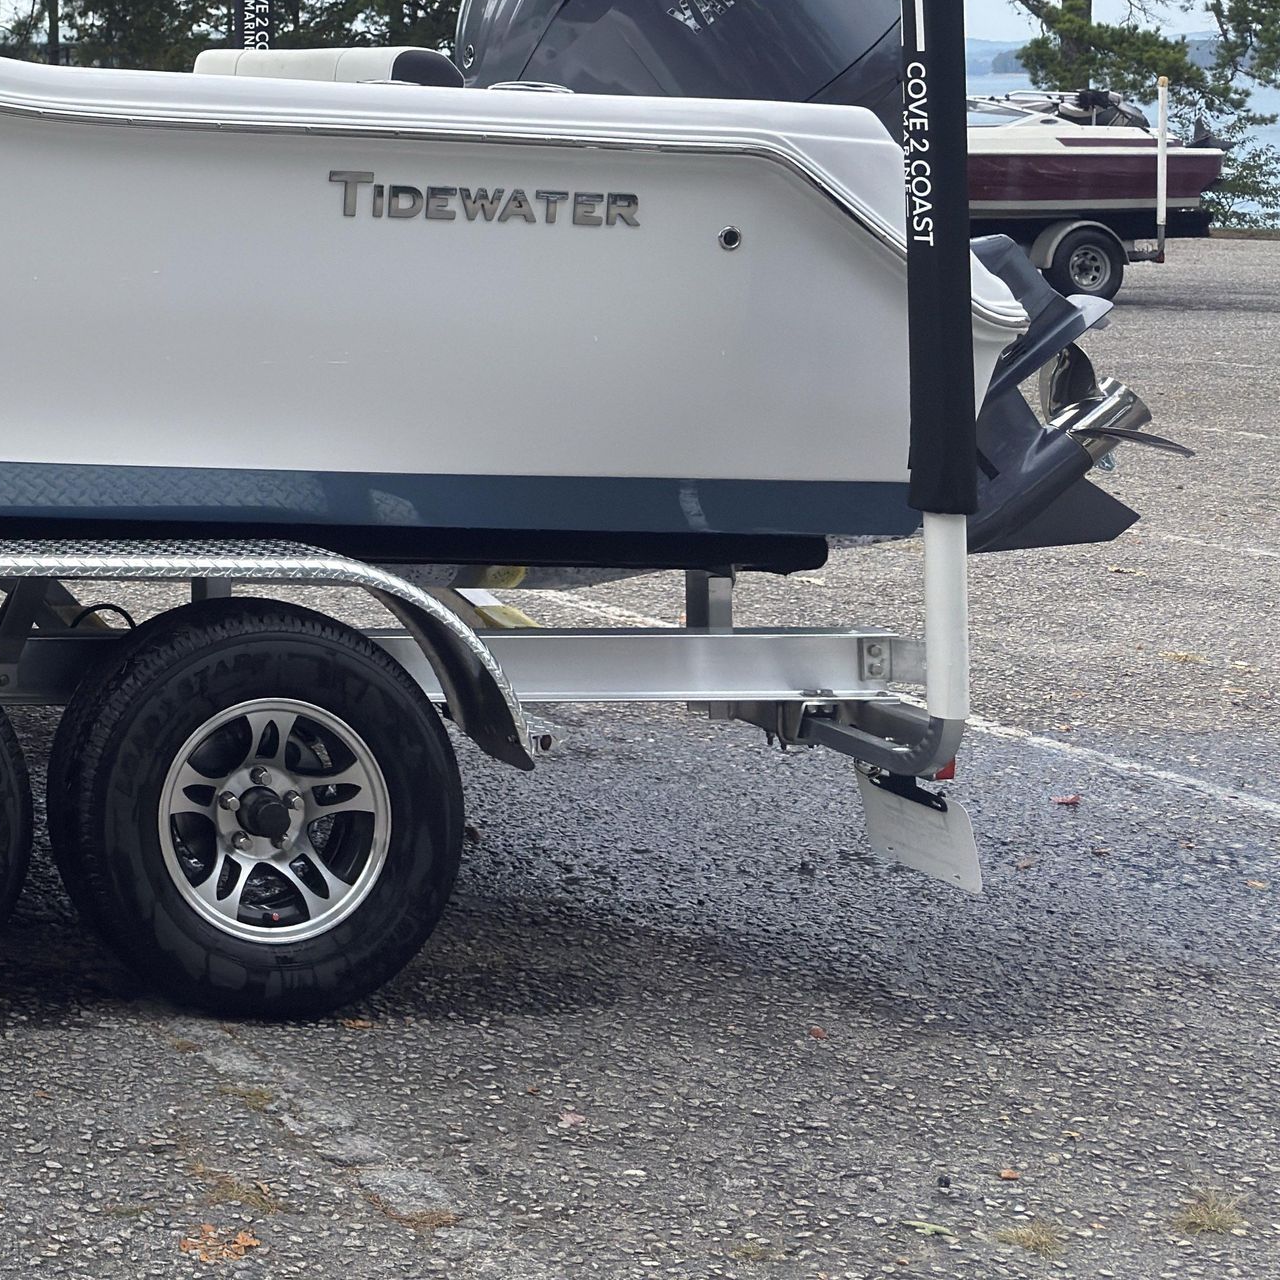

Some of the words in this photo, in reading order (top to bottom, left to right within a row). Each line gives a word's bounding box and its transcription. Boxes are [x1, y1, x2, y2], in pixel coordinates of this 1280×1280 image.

[255, 17, 269, 27] 2
[907, 62, 929, 131] COVE
[910, 138, 930, 153] 2
[328, 170, 641, 227] TIDEWATER
[911, 160, 935, 247] COAST
